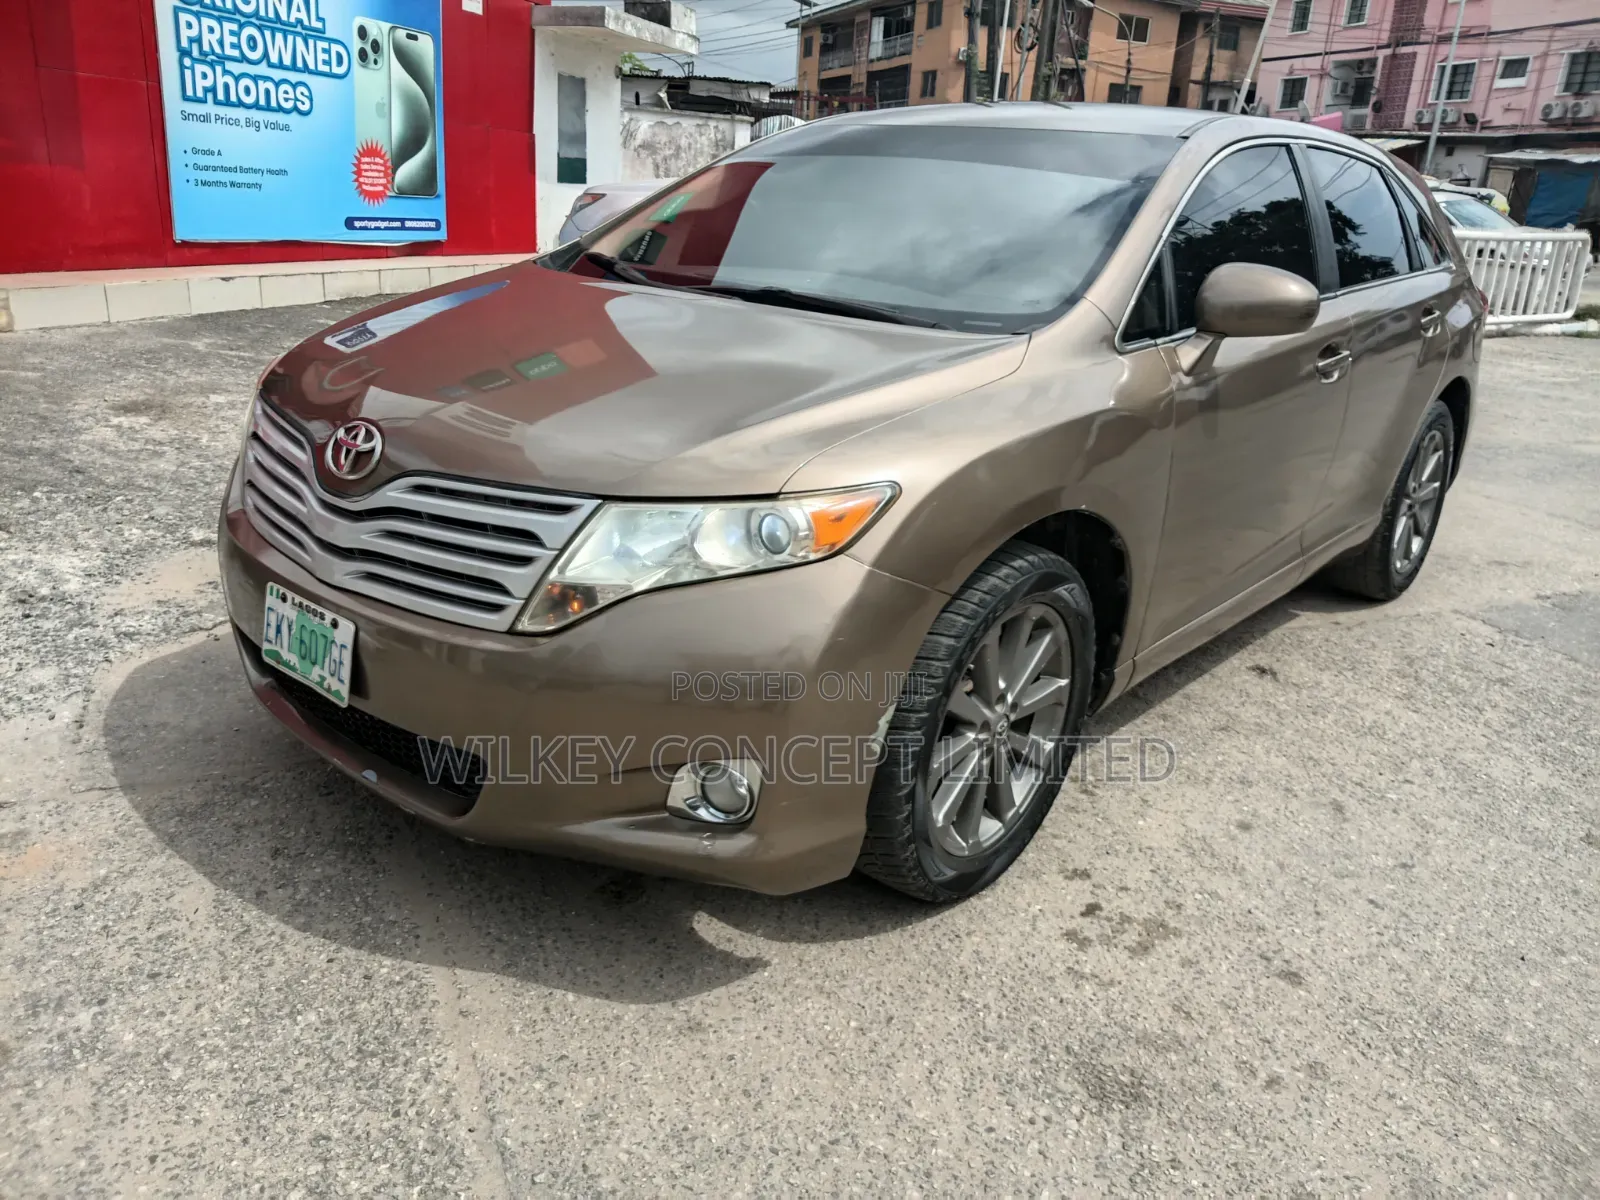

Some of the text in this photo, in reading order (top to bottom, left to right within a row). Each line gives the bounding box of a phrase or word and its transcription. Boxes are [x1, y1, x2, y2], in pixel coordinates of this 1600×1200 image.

[176, 10, 350, 77] PREOWNED
[181, 55, 312, 114] iPhones
[180, 110, 292, 132] Small Price, Big Value.
[191, 147, 215, 156] Grade
[193, 163, 289, 177] Guaranteed Battery Health
[194, 178, 262, 191] 3 Months Warranty
